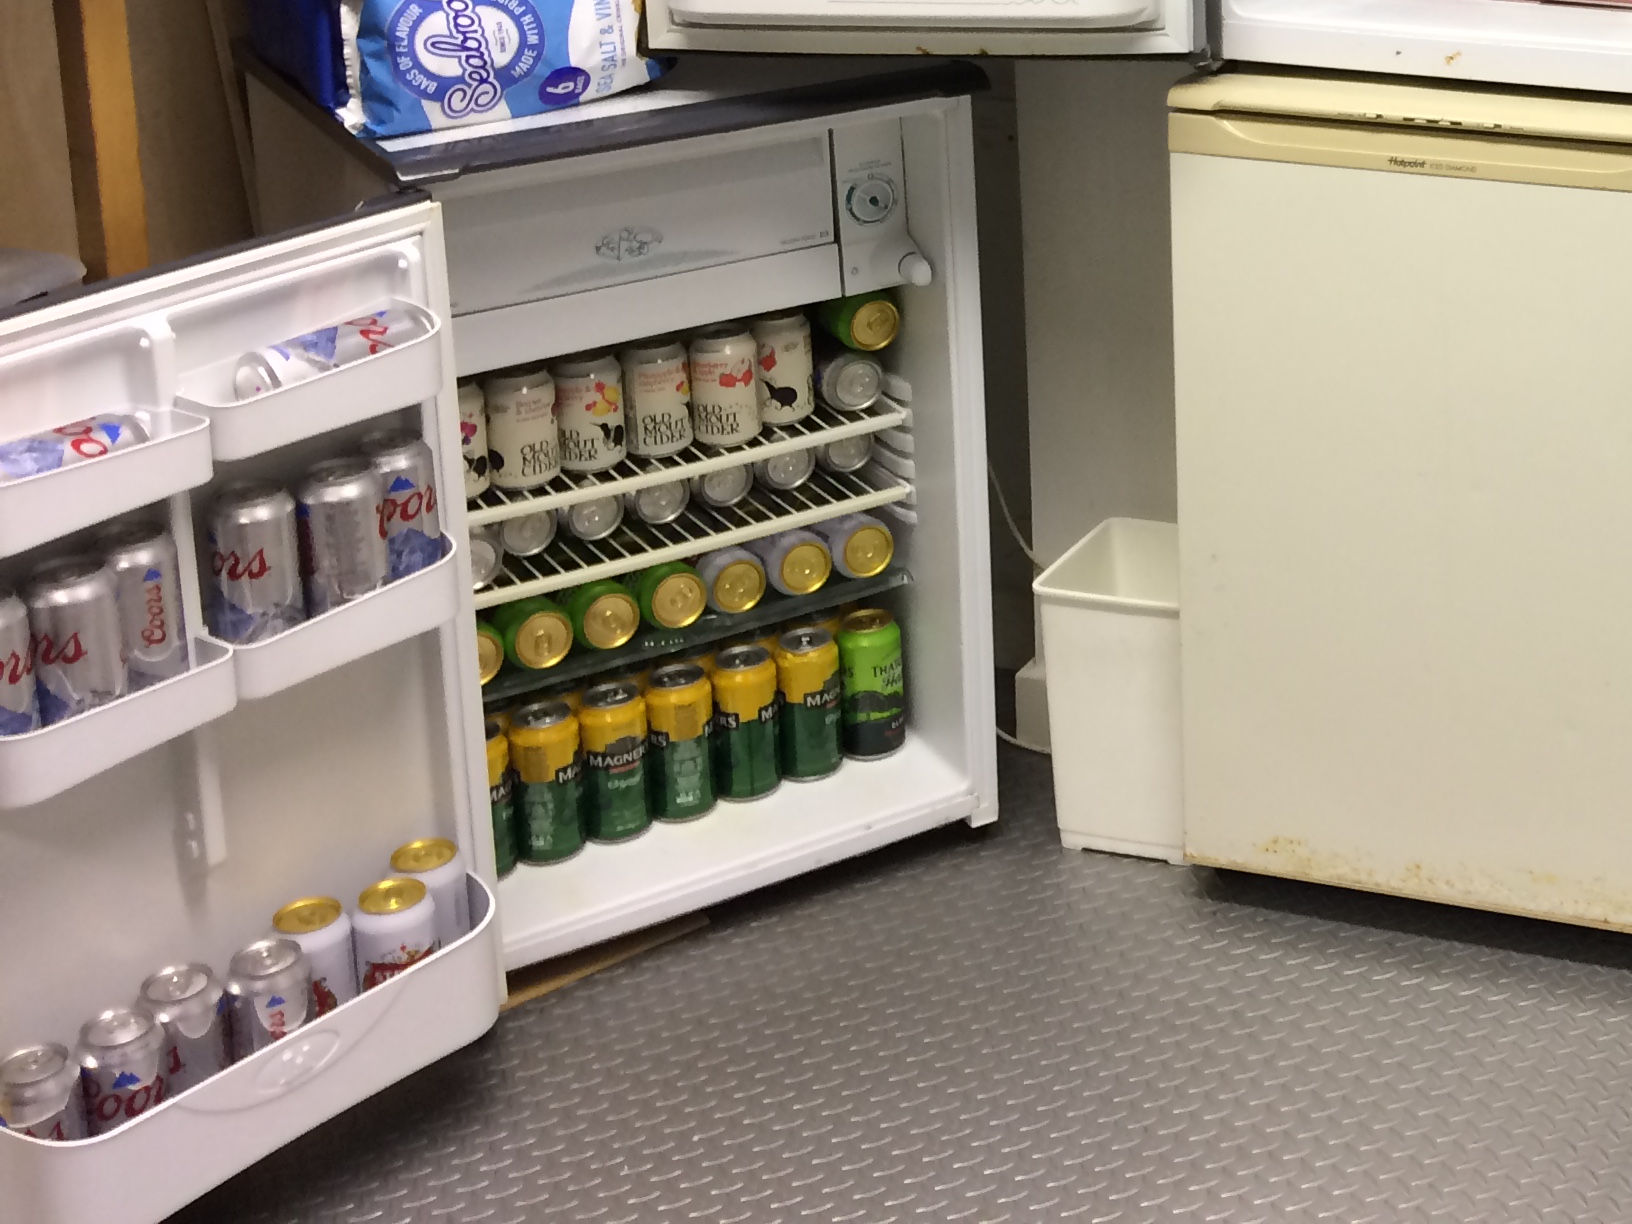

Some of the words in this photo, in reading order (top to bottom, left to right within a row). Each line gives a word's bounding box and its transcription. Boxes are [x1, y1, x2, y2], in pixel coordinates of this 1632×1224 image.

[395, 3, 423, 52] FLAVOUR
[520, 13, 540, 45] WITH
[600, 25, 615, 35] &
[396, 56, 413, 71] OF
[510, 48, 538, 78] MADE
[600, 41, 618, 72] SALT
[406, 68, 438, 94] BAGS
[547, 80, 574, 96] 6
[1387, 156, 1428, 169] Hotpoint
[642, 413, 671, 426] OLD
[643, 428, 686, 447] CIDER
[520, 440, 549, 458] OLD
[141, 583, 166, 647] Coors
